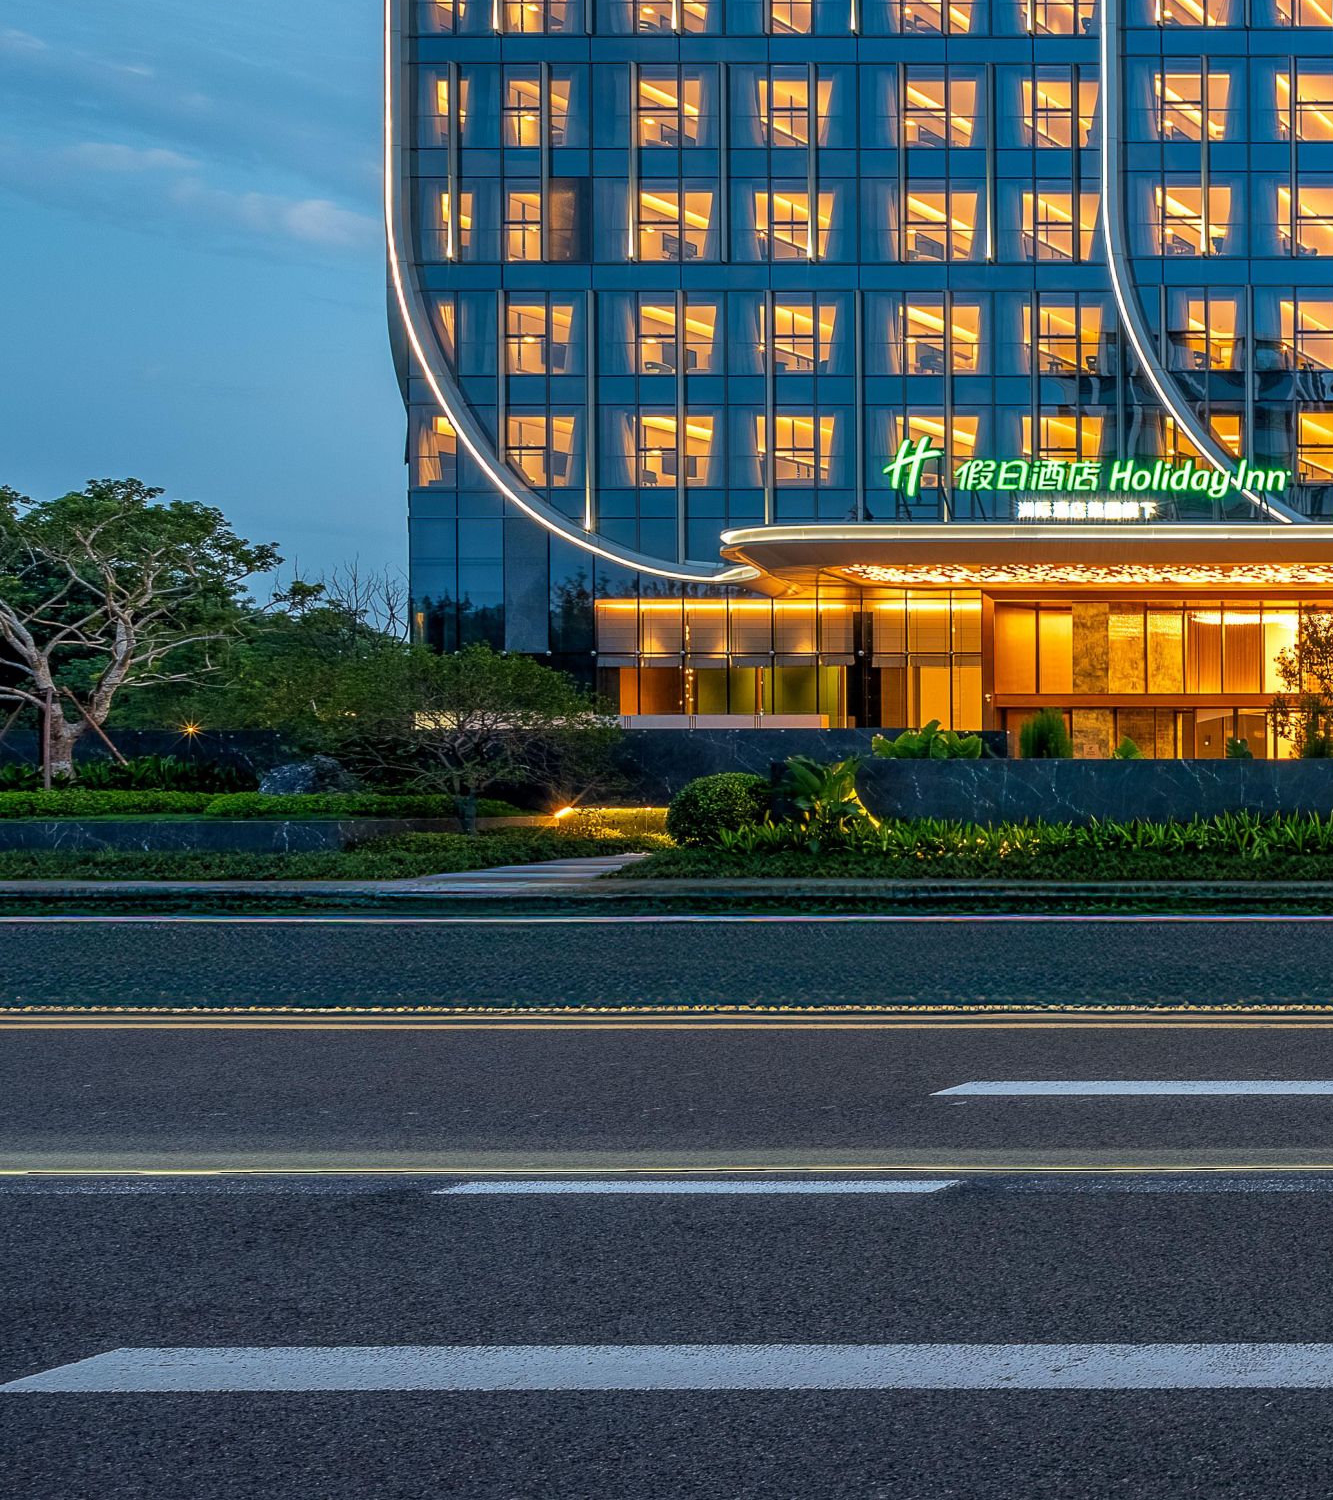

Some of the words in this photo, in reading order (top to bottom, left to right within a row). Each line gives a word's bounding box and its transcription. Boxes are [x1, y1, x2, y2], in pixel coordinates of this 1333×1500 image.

[954, 460, 1101, 491] 假日酒店
[1109, 459, 1231, 498] Holiday
